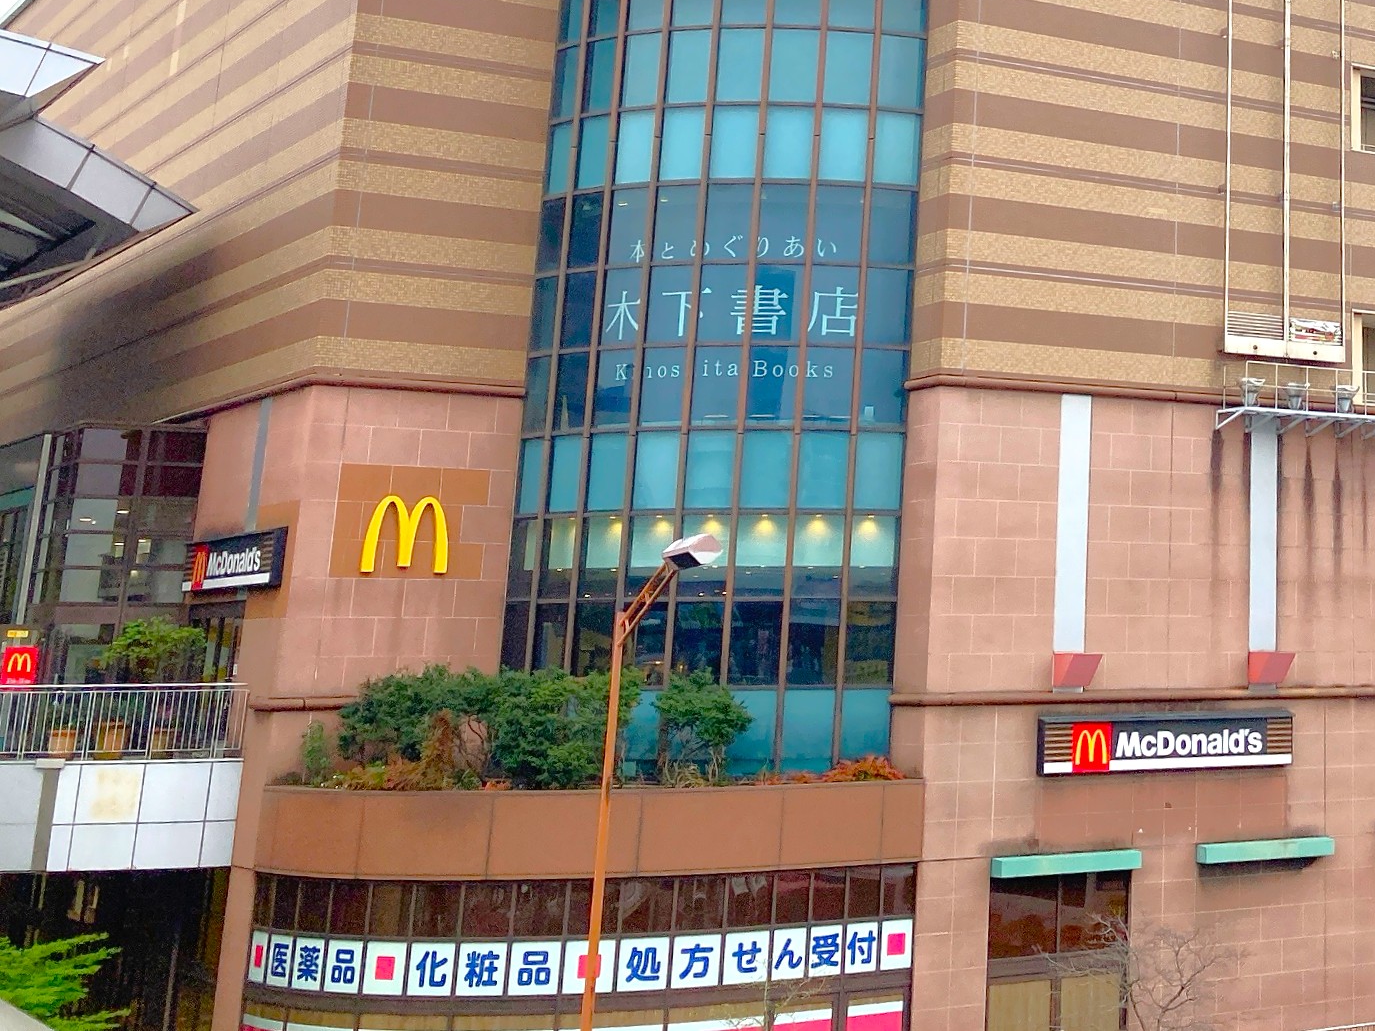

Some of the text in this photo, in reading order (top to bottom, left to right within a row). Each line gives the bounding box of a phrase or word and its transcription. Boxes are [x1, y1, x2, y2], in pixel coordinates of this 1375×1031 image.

[605, 285, 860, 340] 木下書店
[752, 359, 833, 379] Books
[205, 546, 261, 577] McDonald's
[1115, 728, 1263, 759] McDonald's
[416, 950, 552, 987] 化粧品
[625, 929, 877, 983] 処方せん受付
